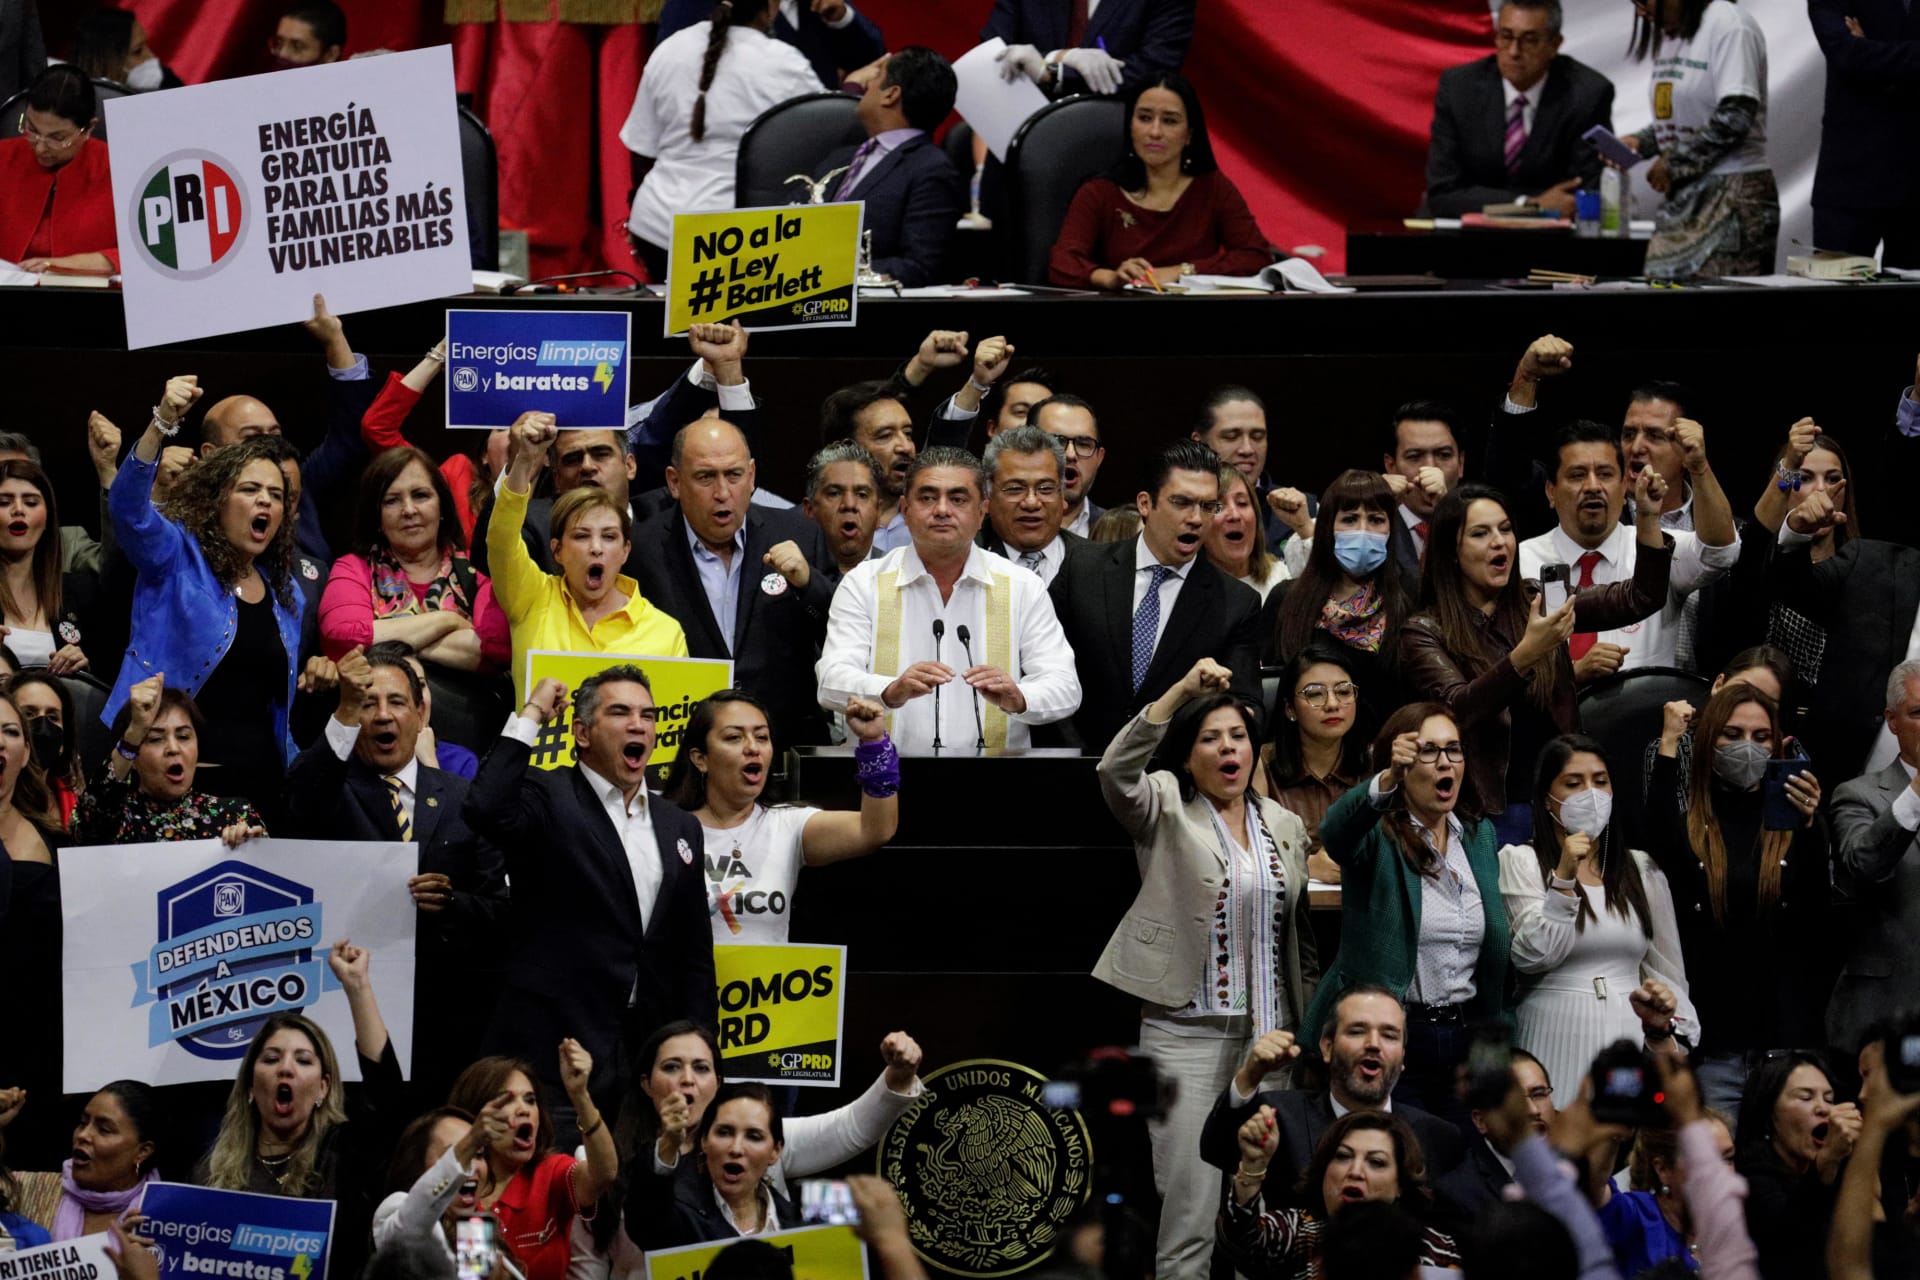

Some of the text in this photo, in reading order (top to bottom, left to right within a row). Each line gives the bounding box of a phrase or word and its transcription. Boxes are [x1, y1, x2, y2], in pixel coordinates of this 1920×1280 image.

[258, 101, 377, 153] ENERGÍA
[261, 136, 392, 183] GRATUITA
[143, 173, 230, 246] PRI
[264, 167, 389, 214] PARA LAS
[266, 181, 453, 244] FAMILIAS MÁS
[268, 218, 453, 274] VULNERABLES
[693, 213, 802, 264] NO a la
[726, 264, 823, 311] Barlett
[451, 342, 620, 366] Energías limpias
[456, 373, 476, 385] PAN
[481, 371, 590, 393] y baratas
[220, 892, 239, 907] PAN
[157, 916, 314, 974] DEFENDEMOS
[215, 959, 233, 980] A
[716, 965, 834, 1012] OMOS
[169, 974, 306, 1031] MÉXICO
[716, 1012, 771, 1050] RD
[781, 1053, 833, 1070] GPPRD
[887, 1070, 1085, 1168] ESTADOS UNIDOS MICANOS
[139, 1216, 321, 1256] Energías limpias
[18, 1247, 63, 1275] TIENE
[61, 1245, 82, 1265] LA
[168, 1255, 180, 1272] y
[182, 1251, 285, 1280] baratas
